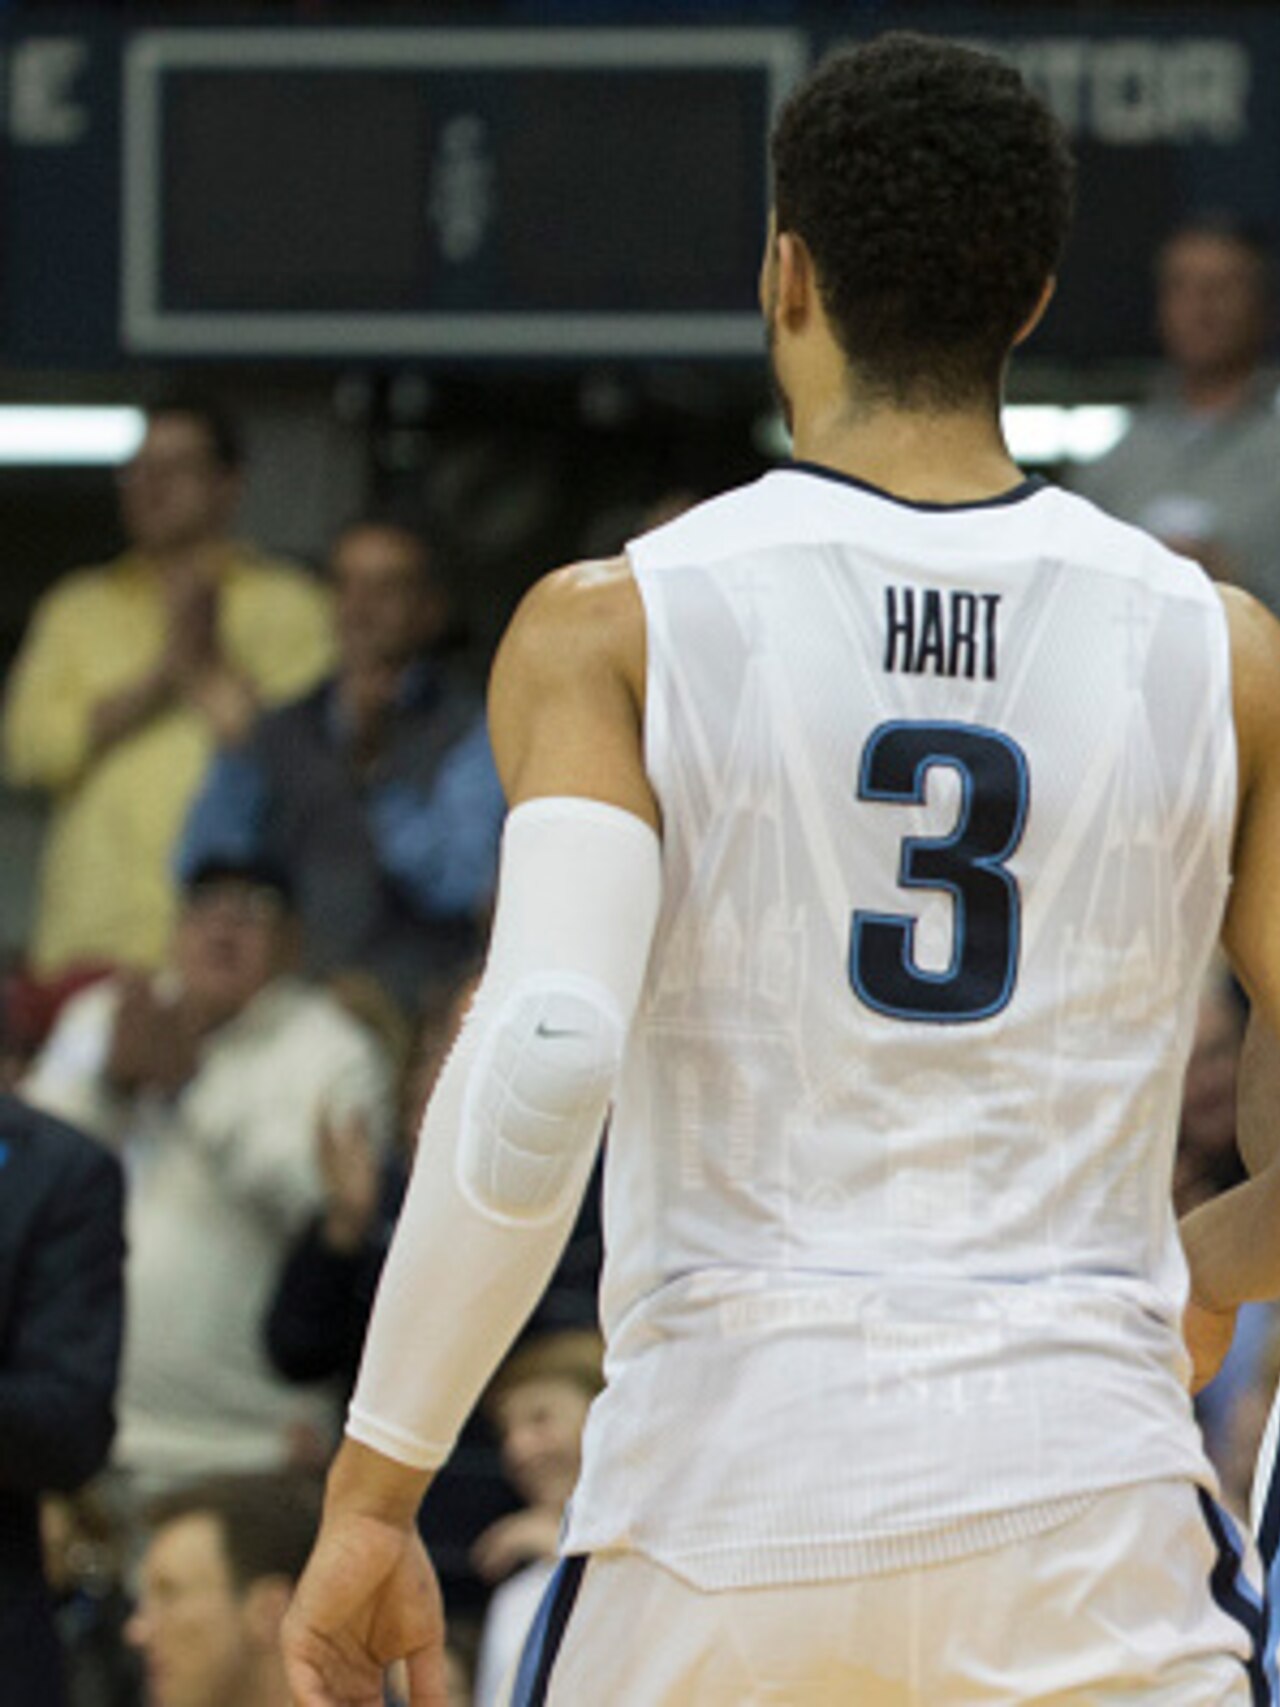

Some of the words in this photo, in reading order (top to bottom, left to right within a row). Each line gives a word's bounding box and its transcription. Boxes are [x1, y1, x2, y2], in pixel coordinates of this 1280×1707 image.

[1005, 42, 1248, 142] TOR
[883, 585, 1002, 680] HART
[848, 719, 1031, 1024] 3
